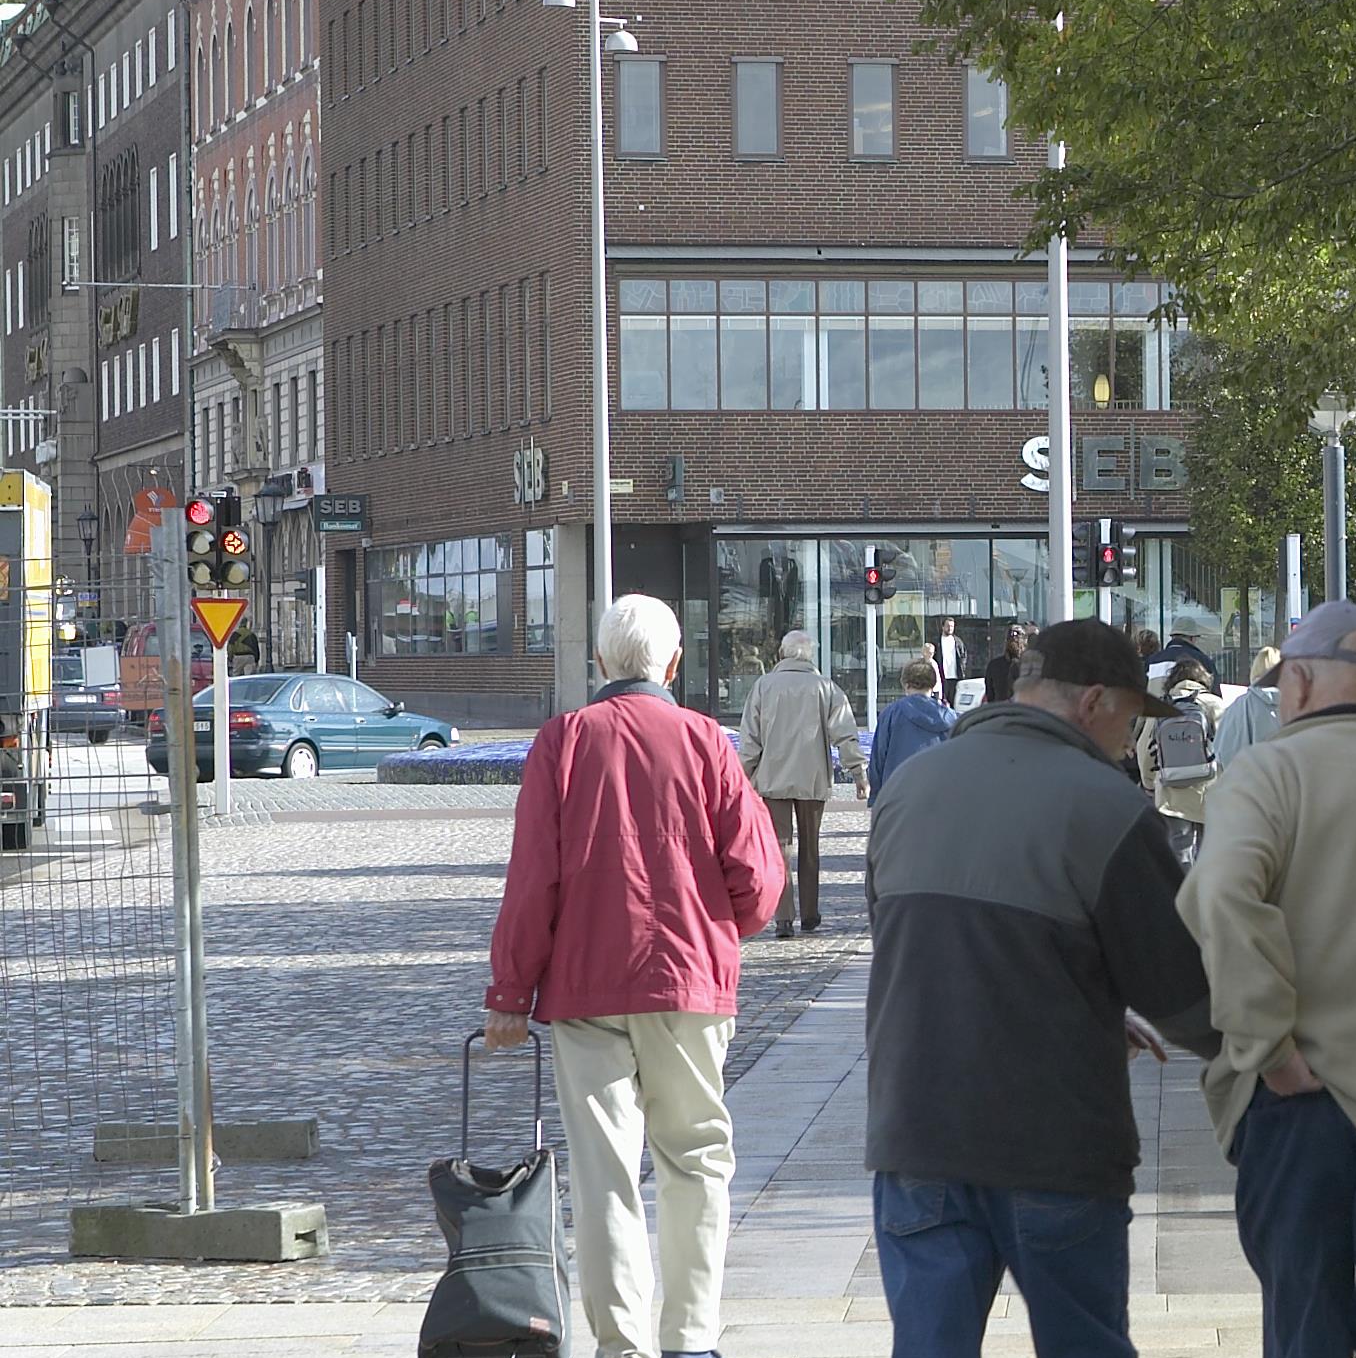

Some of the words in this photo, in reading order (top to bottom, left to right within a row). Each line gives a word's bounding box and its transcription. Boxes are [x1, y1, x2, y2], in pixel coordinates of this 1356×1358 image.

[513, 447, 545, 504] SEB
[1020, 436, 1189, 491] SEB
[320, 500, 361, 514] SEB
